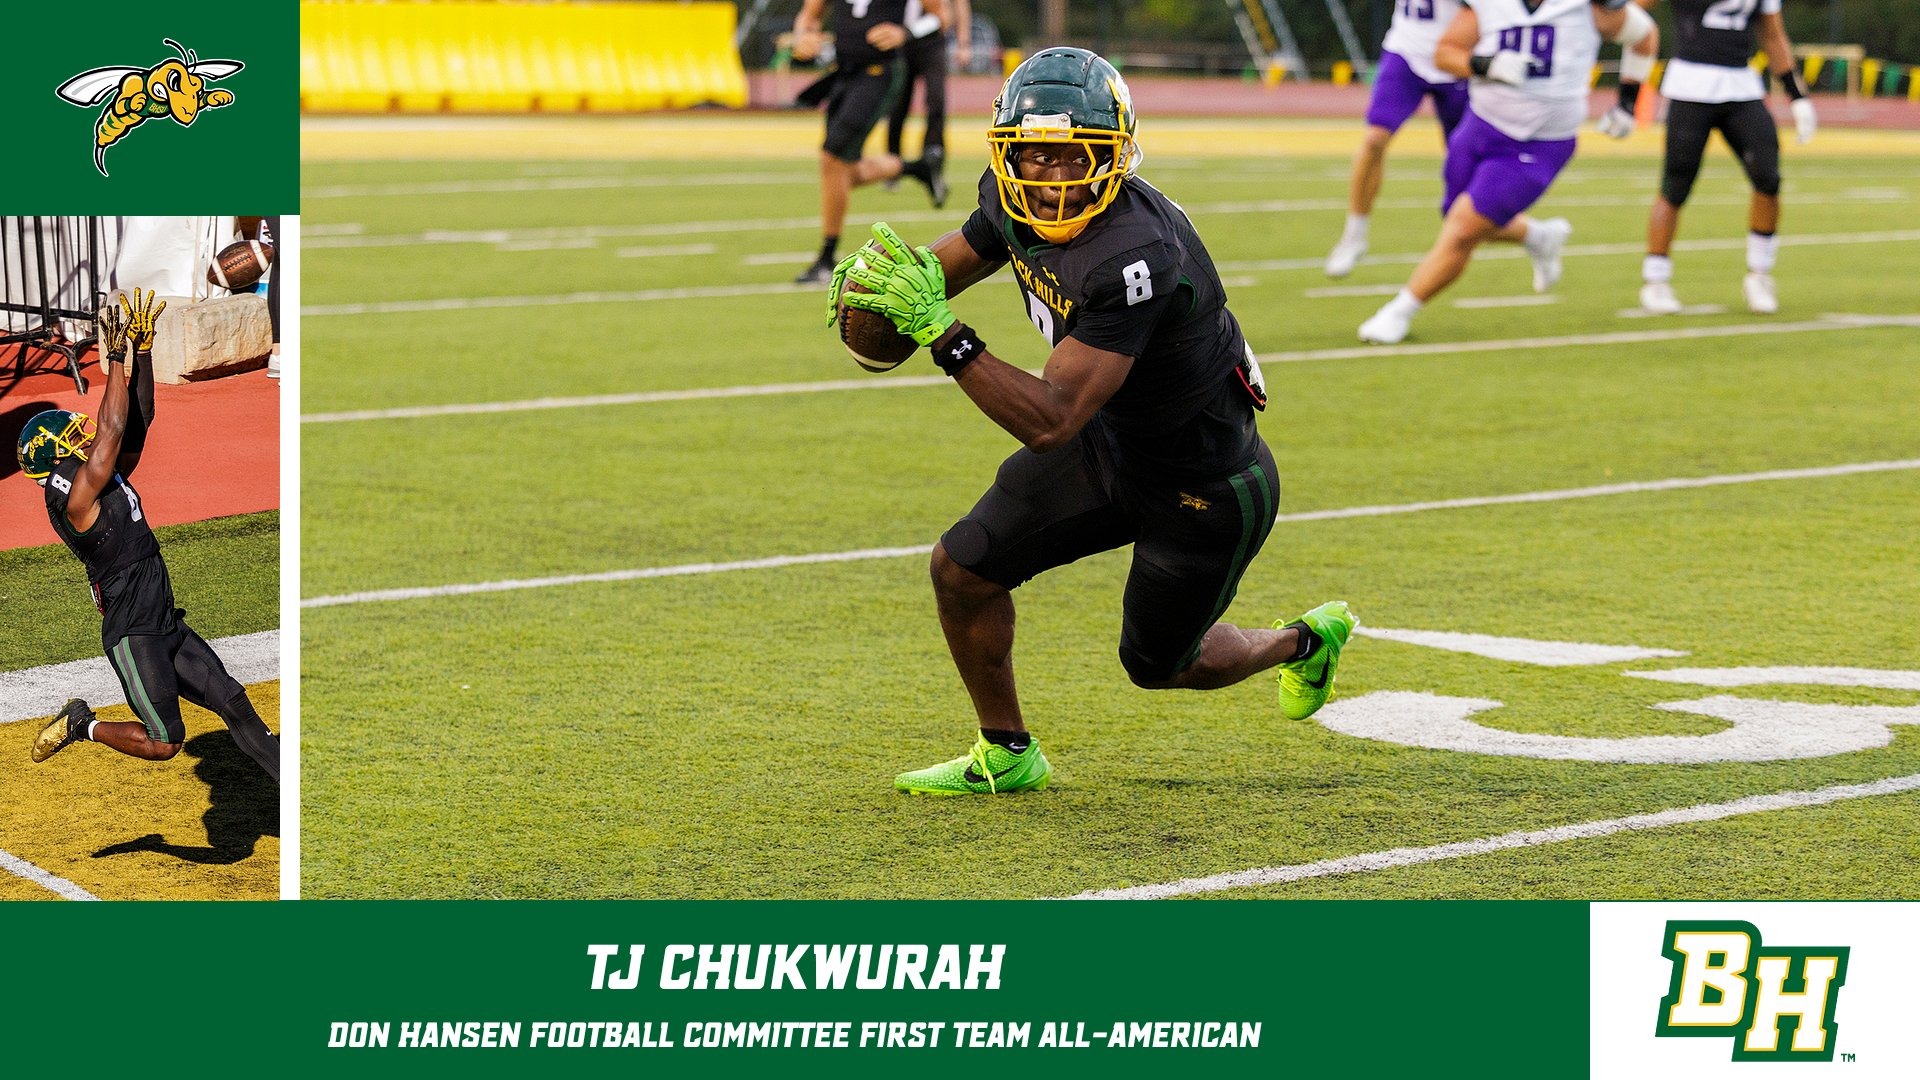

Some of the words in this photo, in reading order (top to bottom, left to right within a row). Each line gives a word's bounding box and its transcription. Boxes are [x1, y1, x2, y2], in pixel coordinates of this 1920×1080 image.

[1034, 276, 1073, 320] HILLS
[1122, 259, 1153, 306] 8
[51, 473, 73, 495] 8
